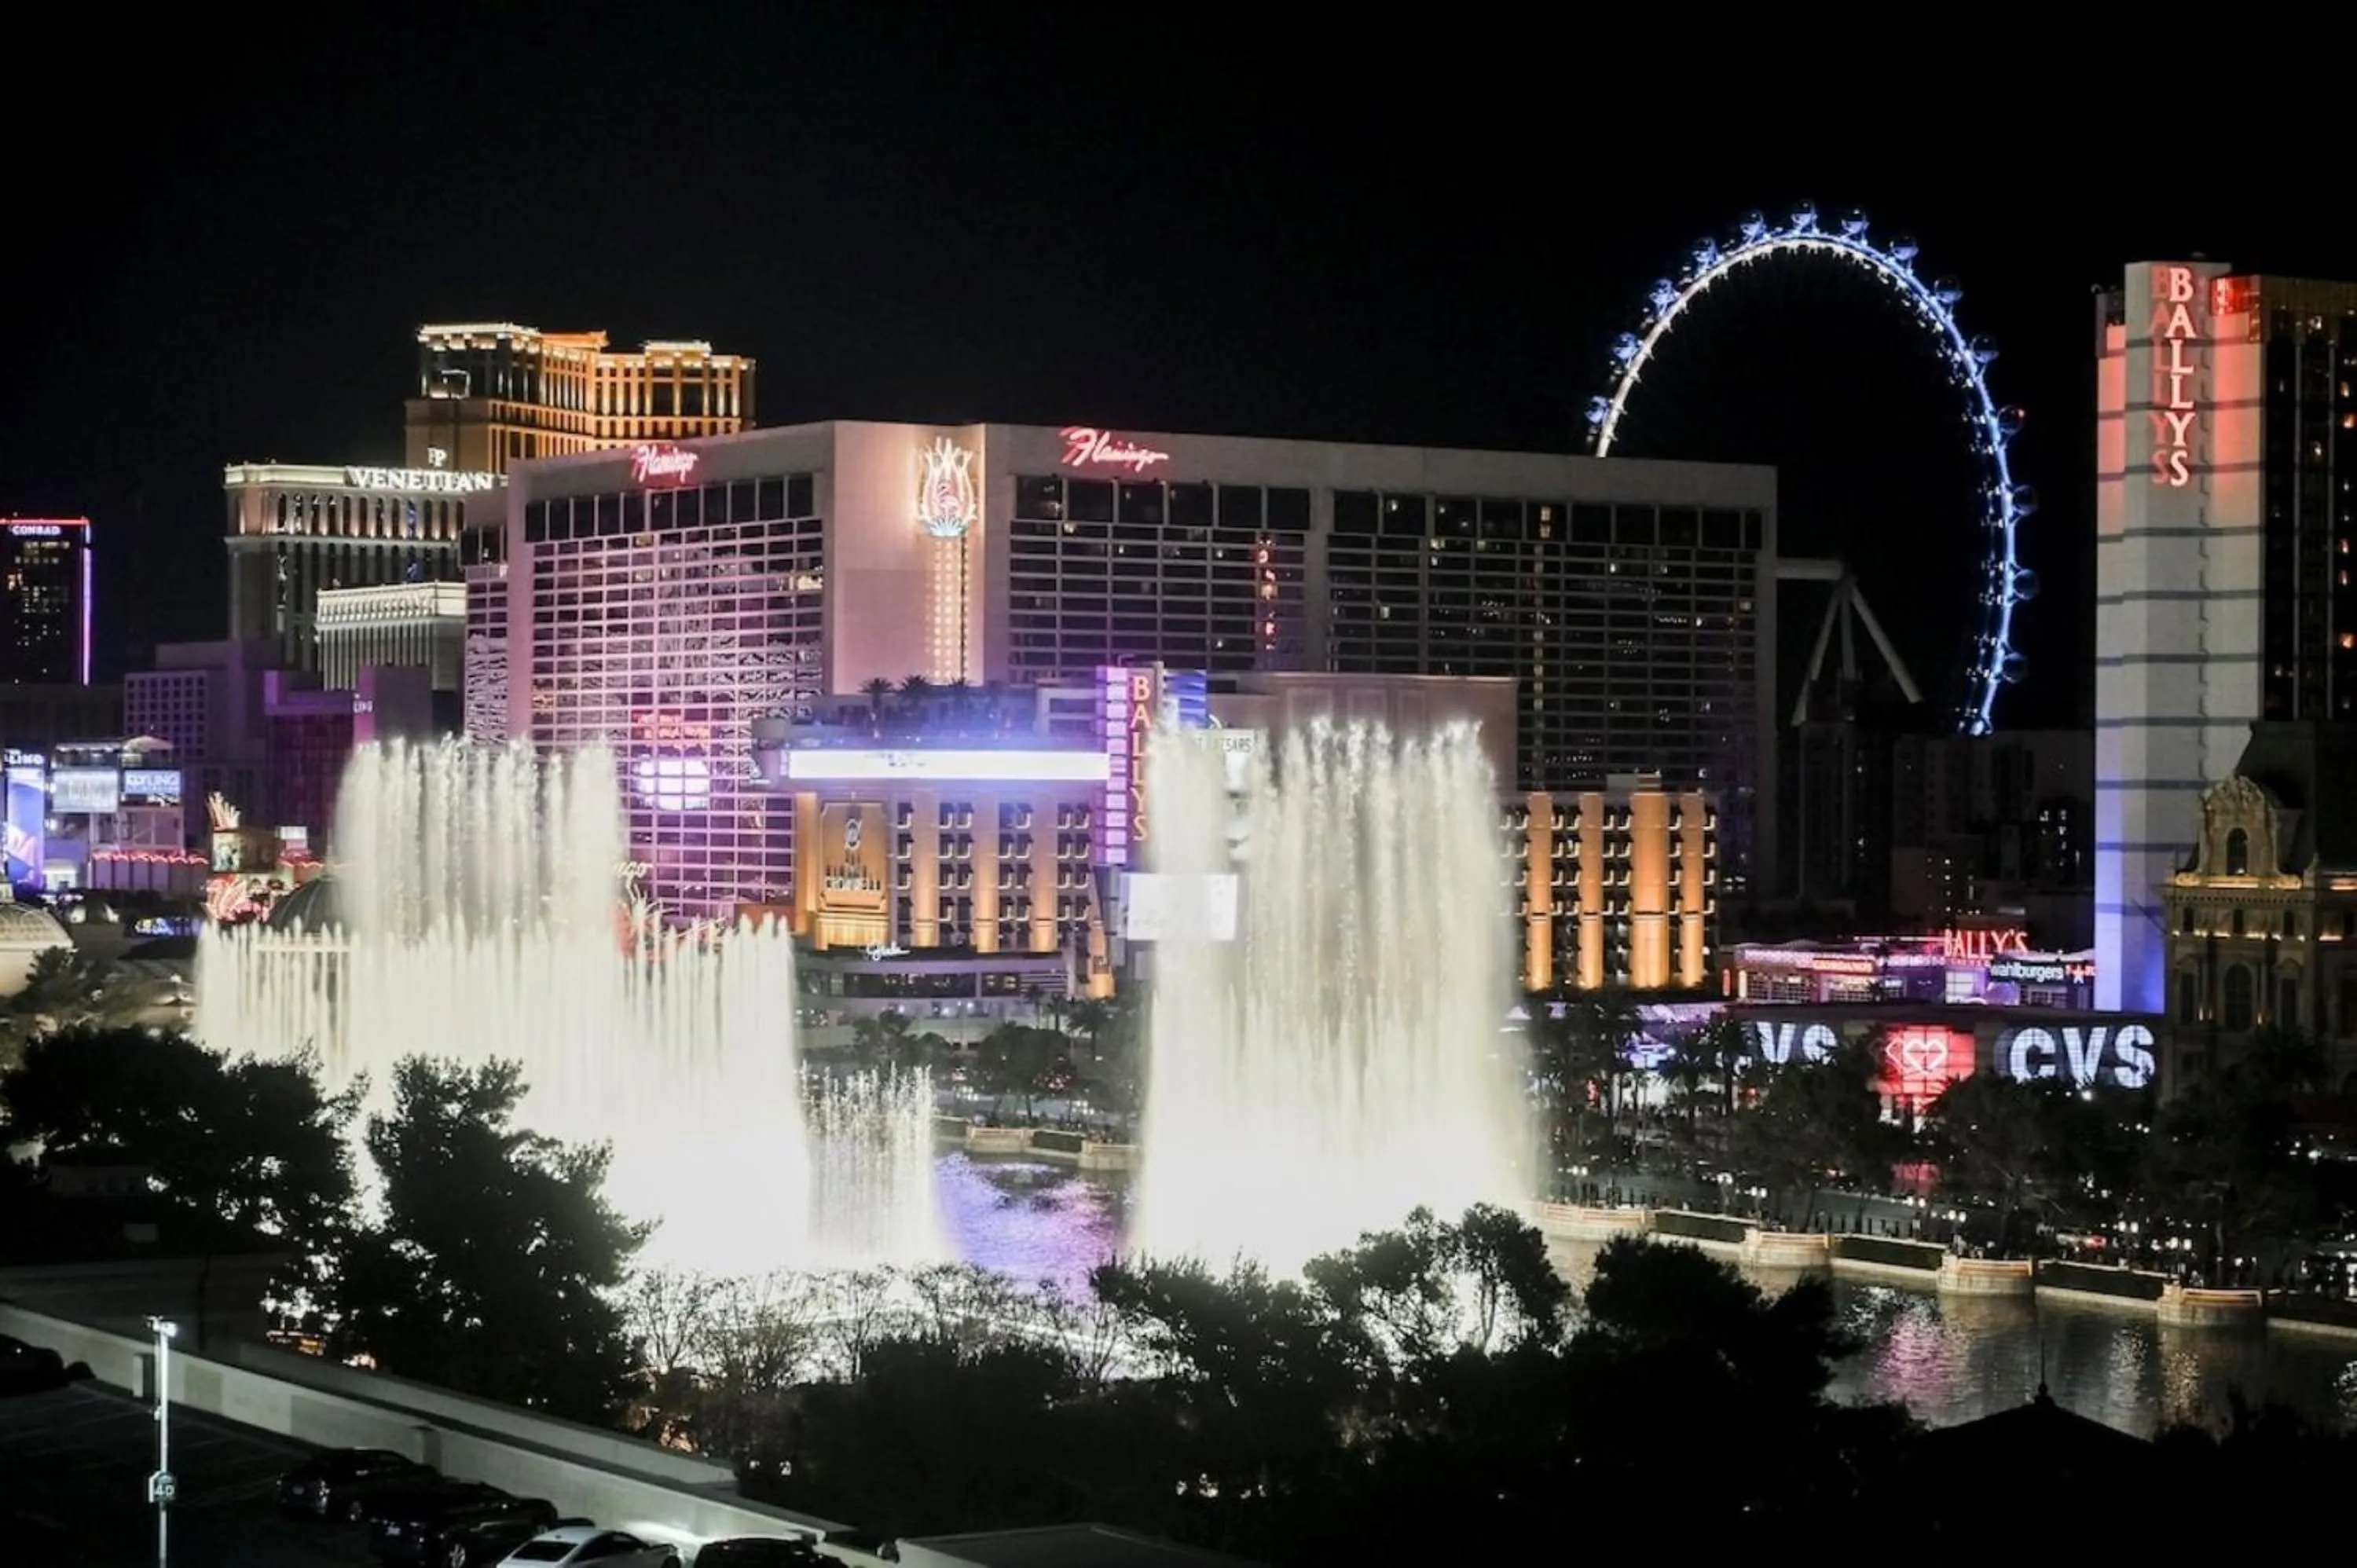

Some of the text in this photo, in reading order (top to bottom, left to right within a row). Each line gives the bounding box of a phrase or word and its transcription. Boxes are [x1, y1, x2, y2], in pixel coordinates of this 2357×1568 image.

[1067, 427, 1170, 473] Flamingo
[346, 465, 495, 492] VENETIAN
[12, 526, 61, 536] CONRAD
[1944, 928, 2029, 959] BALLY'S
[2010, 1024, 2156, 1090] CVS
